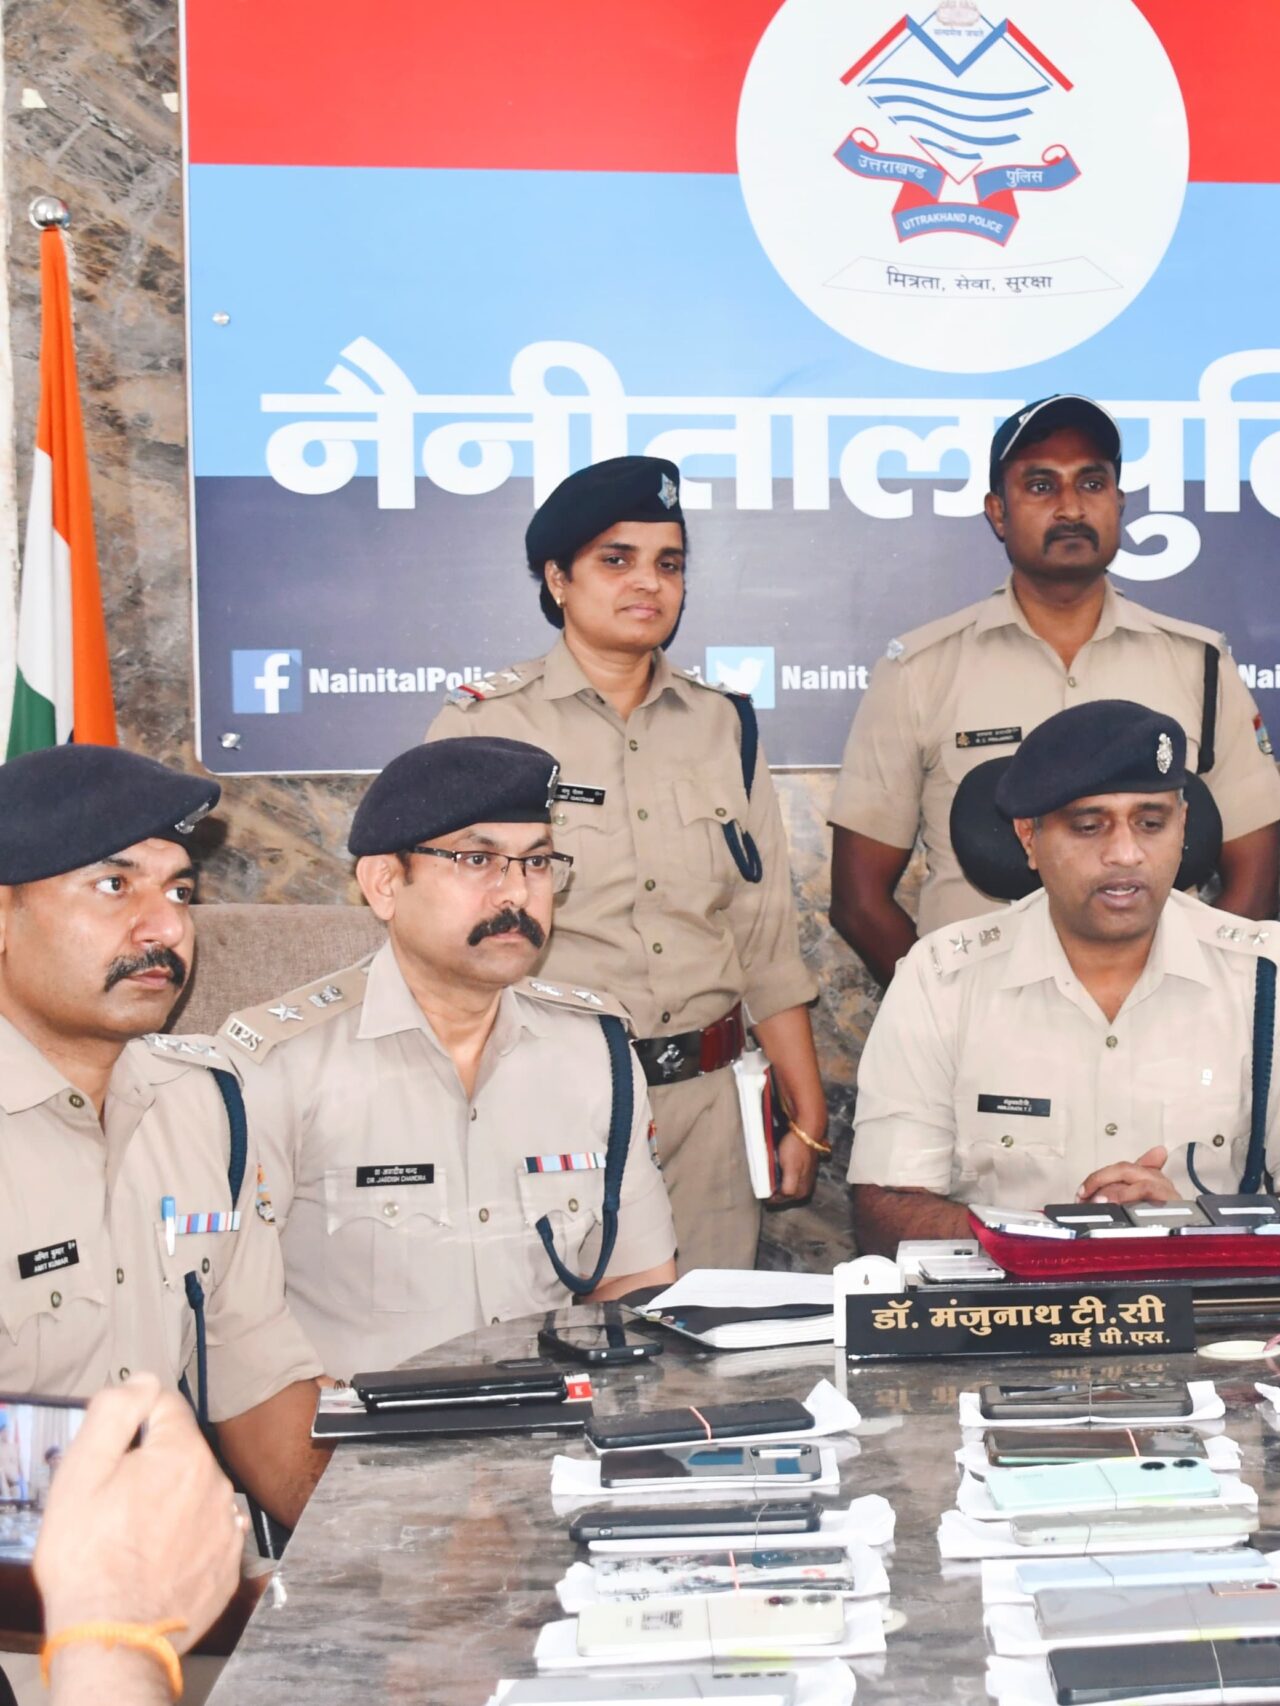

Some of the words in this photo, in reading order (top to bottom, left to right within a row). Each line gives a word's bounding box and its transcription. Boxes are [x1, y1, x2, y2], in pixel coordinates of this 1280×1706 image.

[857, 154, 928, 180] उत्तराखण्ड
[1005, 167, 1044, 188] पुलिस
[902, 212, 967, 231] UTTRAKHAND
[968, 213, 1004, 234] POLICE
[886, 265, 946, 292] मित्रता,
[954, 274, 996, 292] सेवा,
[1004, 275, 1053, 293] सुरक्षा
[261, 336, 1026, 519] नैनीताल
[309, 666, 497, 694] NainitalPoli
[928, 1298, 1062, 1337] मंजुनाथ
[1049, 1330, 1092, 1348] आई
